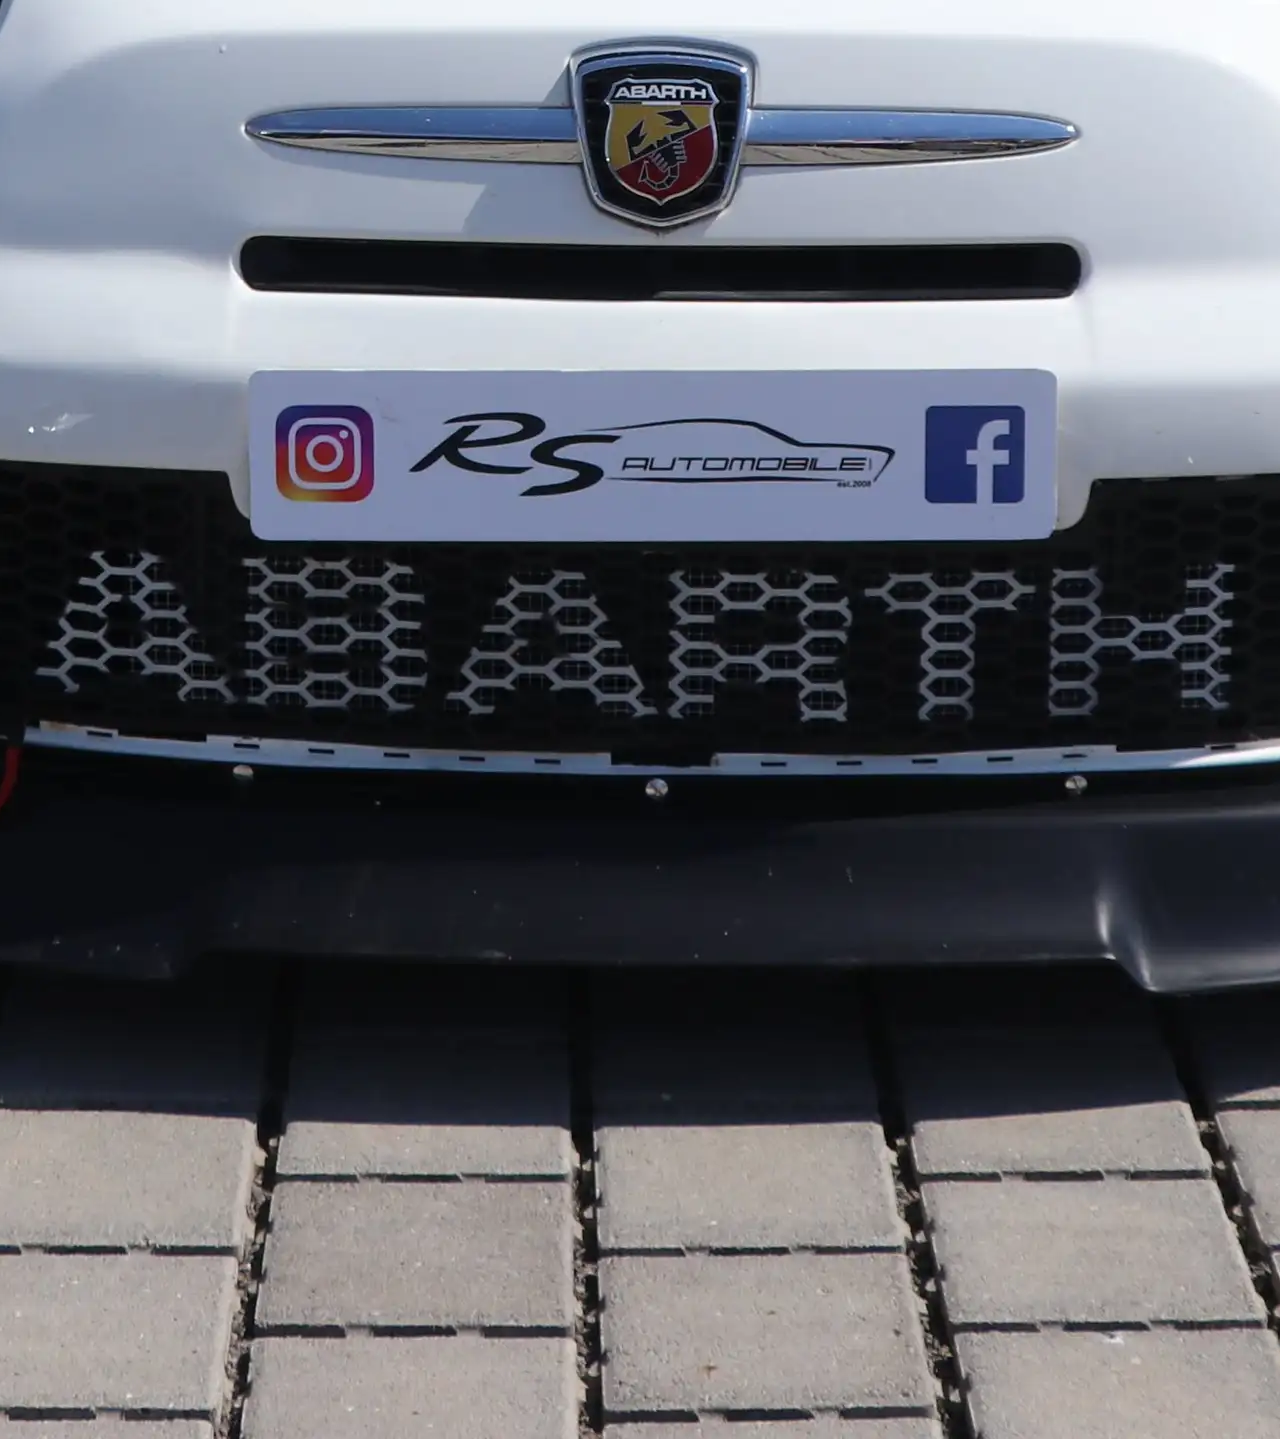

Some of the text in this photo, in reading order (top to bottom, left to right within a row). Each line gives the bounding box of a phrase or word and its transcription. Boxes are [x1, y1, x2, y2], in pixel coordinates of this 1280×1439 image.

[614, 85, 707, 100] ABARTH
[409, 411, 867, 497] RS AUTOMOBILE
[35, 550, 1235, 723] ABARTH
